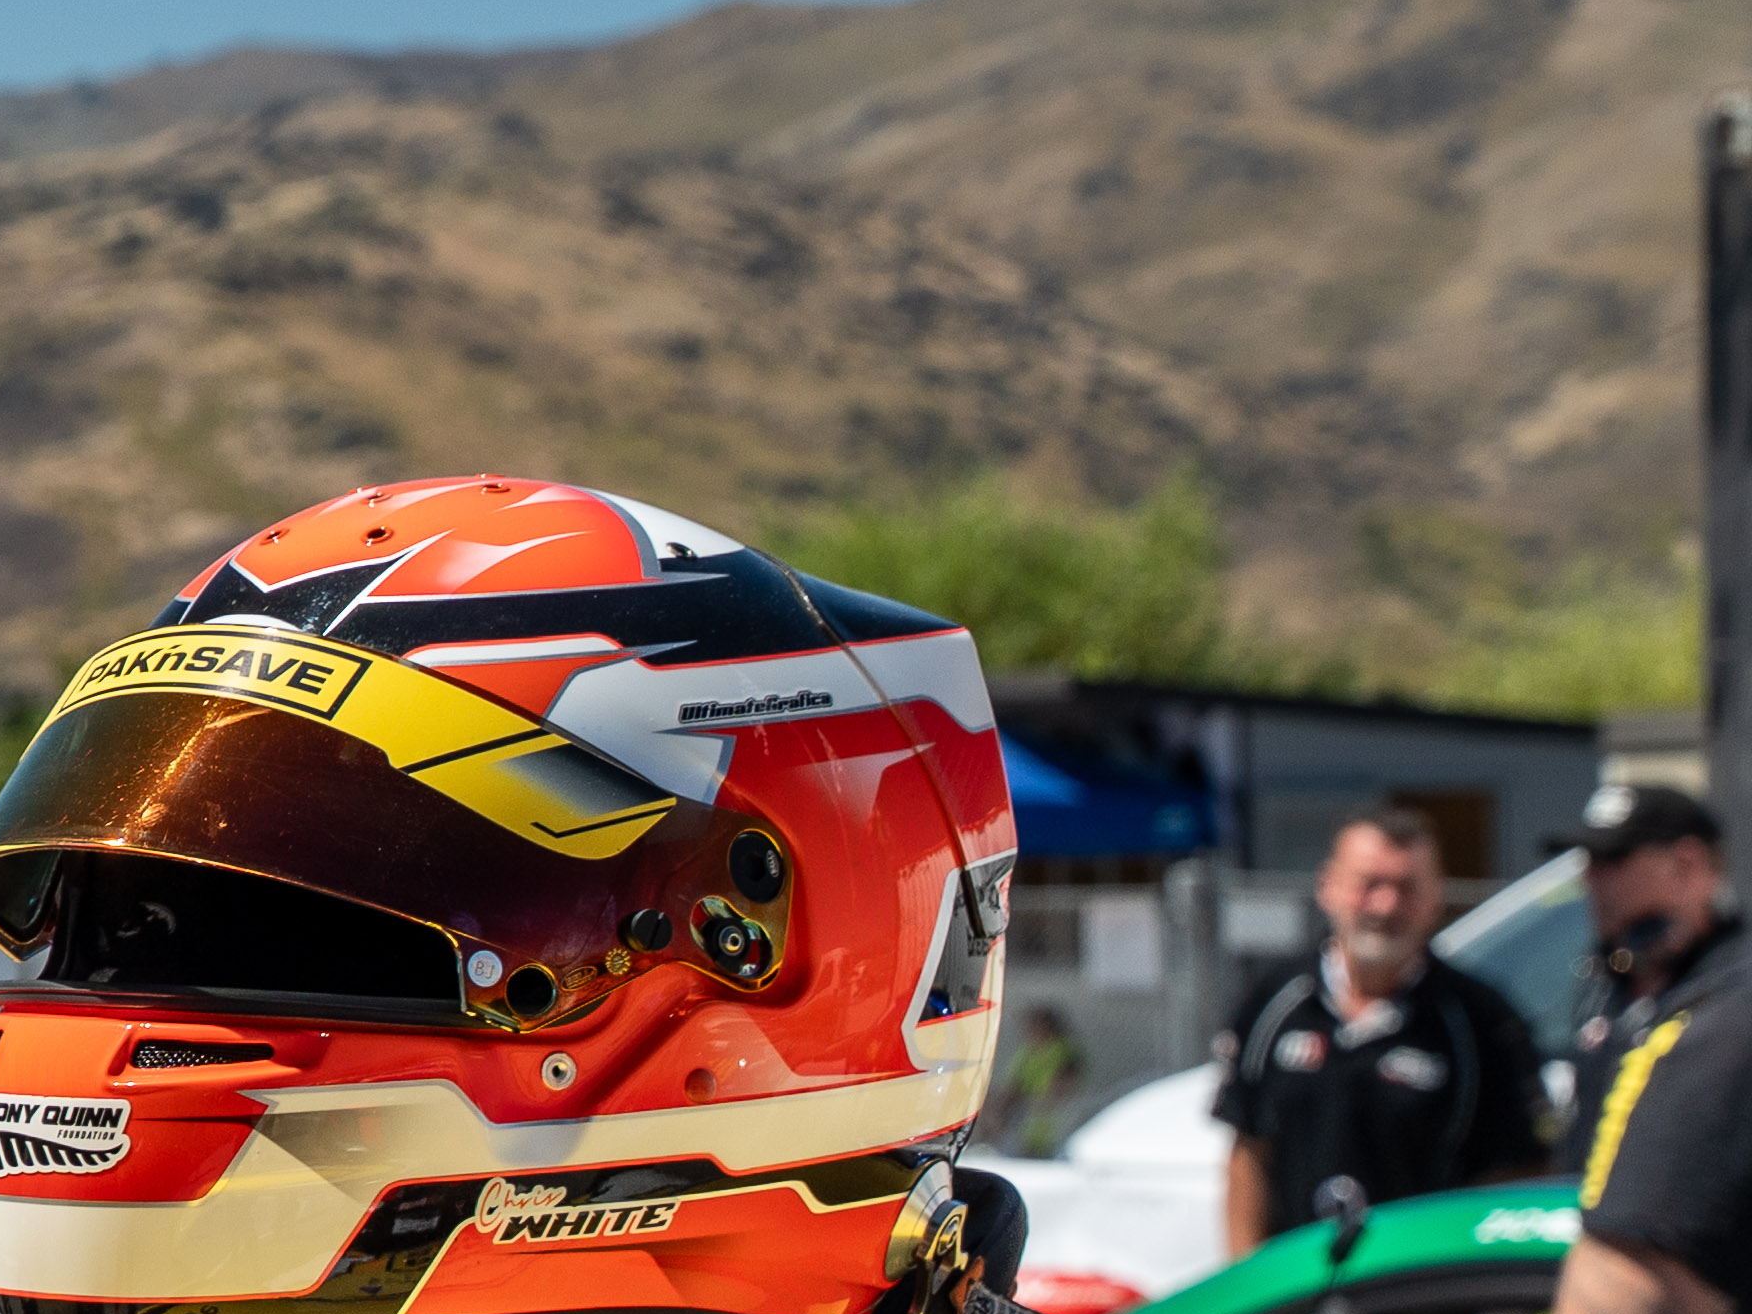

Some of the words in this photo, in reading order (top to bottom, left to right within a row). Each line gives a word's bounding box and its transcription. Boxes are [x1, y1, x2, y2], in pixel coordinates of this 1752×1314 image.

[42, 1105, 124, 1128] QUINN
[56, 1129, 116, 1141] FOUNDATION
[480, 1181, 560, 1227] Chris
[499, 1202, 677, 1242] WHITE
